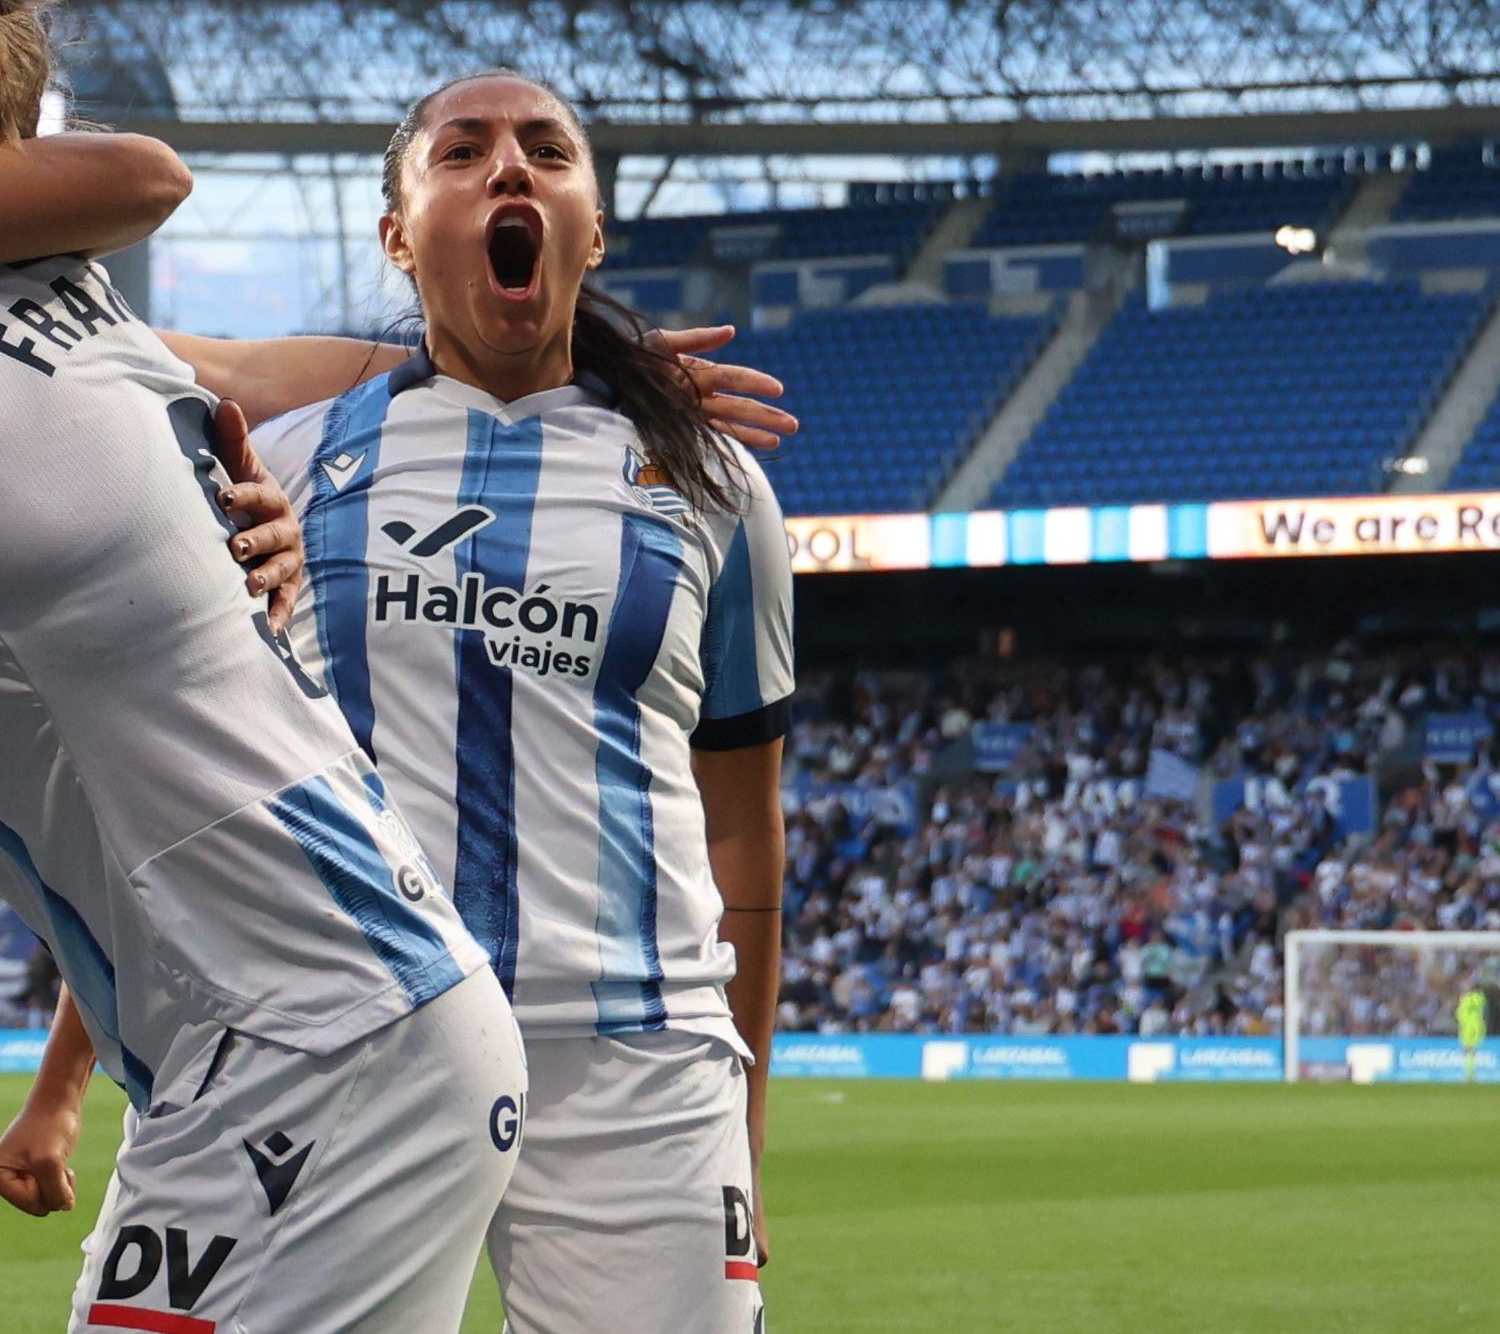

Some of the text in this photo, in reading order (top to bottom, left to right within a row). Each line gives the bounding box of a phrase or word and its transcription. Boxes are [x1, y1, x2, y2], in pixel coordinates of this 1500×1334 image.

[1259, 509, 1336, 545] We
[1355, 512, 1439, 543] are
[374, 574, 599, 642] Halcón
[487, 635, 592, 677] viajes
[1399, 1049, 1499, 1068] LARZAAL
[722, 1185, 757, 1258] D
[98, 1224, 238, 1310] DV
